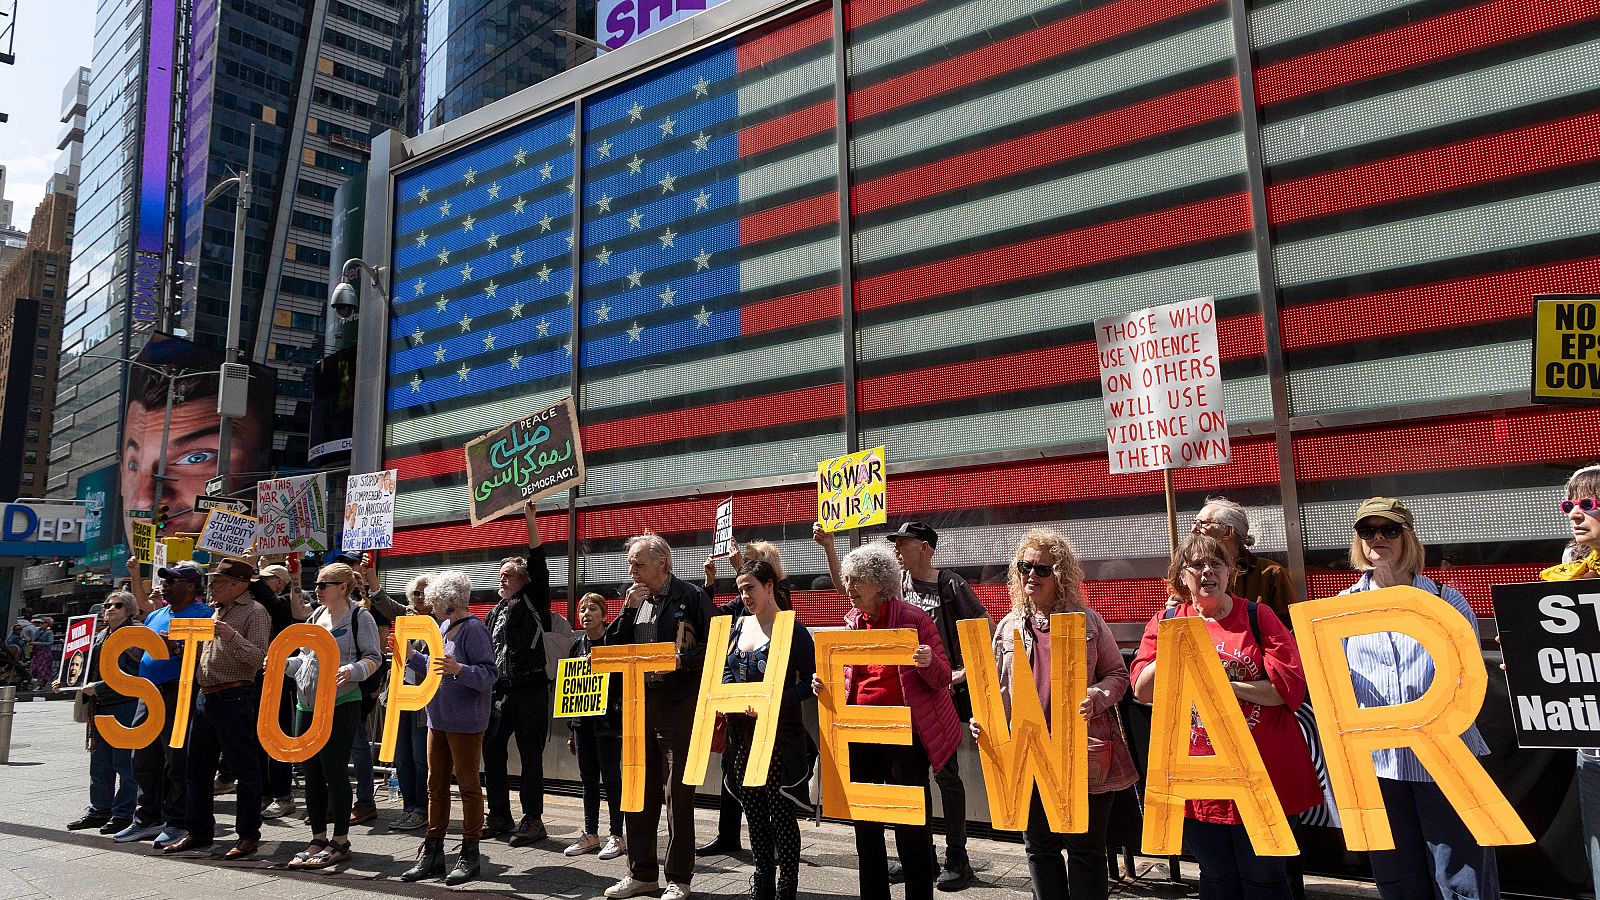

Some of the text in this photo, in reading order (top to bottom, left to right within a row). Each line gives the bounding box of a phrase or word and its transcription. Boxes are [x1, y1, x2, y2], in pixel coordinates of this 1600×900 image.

[1102, 303, 1213, 343] THOSE WHO
[1555, 303, 1596, 331] NO
[1100, 332, 1201, 369] USE VIOLENCE
[1561, 333, 1600, 360] EP
[1107, 355, 1216, 393] ON OTHERS
[1110, 385, 1209, 418] WILL USE
[520, 407, 559, 431] PEACE
[1107, 410, 1226, 445] VIOLENCE ON
[341, 440, 353, 449] CH
[489, 424, 551, 469] صلح
[1116, 438, 1228, 470] THEIR OWN
[258, 479, 291, 493] HOW THIS
[349, 476, 358, 490] TOO
[521, 464, 575, 497] DEMOCRACY
[203, 501, 244, 512] ONE WAY
[259, 490, 279, 504] WAR
[347, 490, 353, 504] TO
[821, 492, 884, 521] ON IRAN
[3, 504, 91, 542] DEPT
[216, 511, 256, 529] TRUMP'S
[258, 513, 273, 525] WILL
[276, 523, 286, 534] BE
[361, 516, 368, 529] TO
[209, 520, 255, 539] STUPIDITY
[211, 531, 245, 546] CAUSED
[206, 538, 245, 555] THIS WAR
[259, 536, 276, 549] PAID
[277, 535, 290, 548] FOR
[361, 537, 373, 549] HIS
[374, 534, 392, 548] WAR
[71, 623, 87, 641] WAR
[564, 660, 596, 677] IMPEA
[563, 675, 604, 694] CONVICT
[561, 693, 601, 713] REMOVE
[94, 585, 1537, 858] STOP THE WAR
[1517, 695, 1600, 731] Nati
